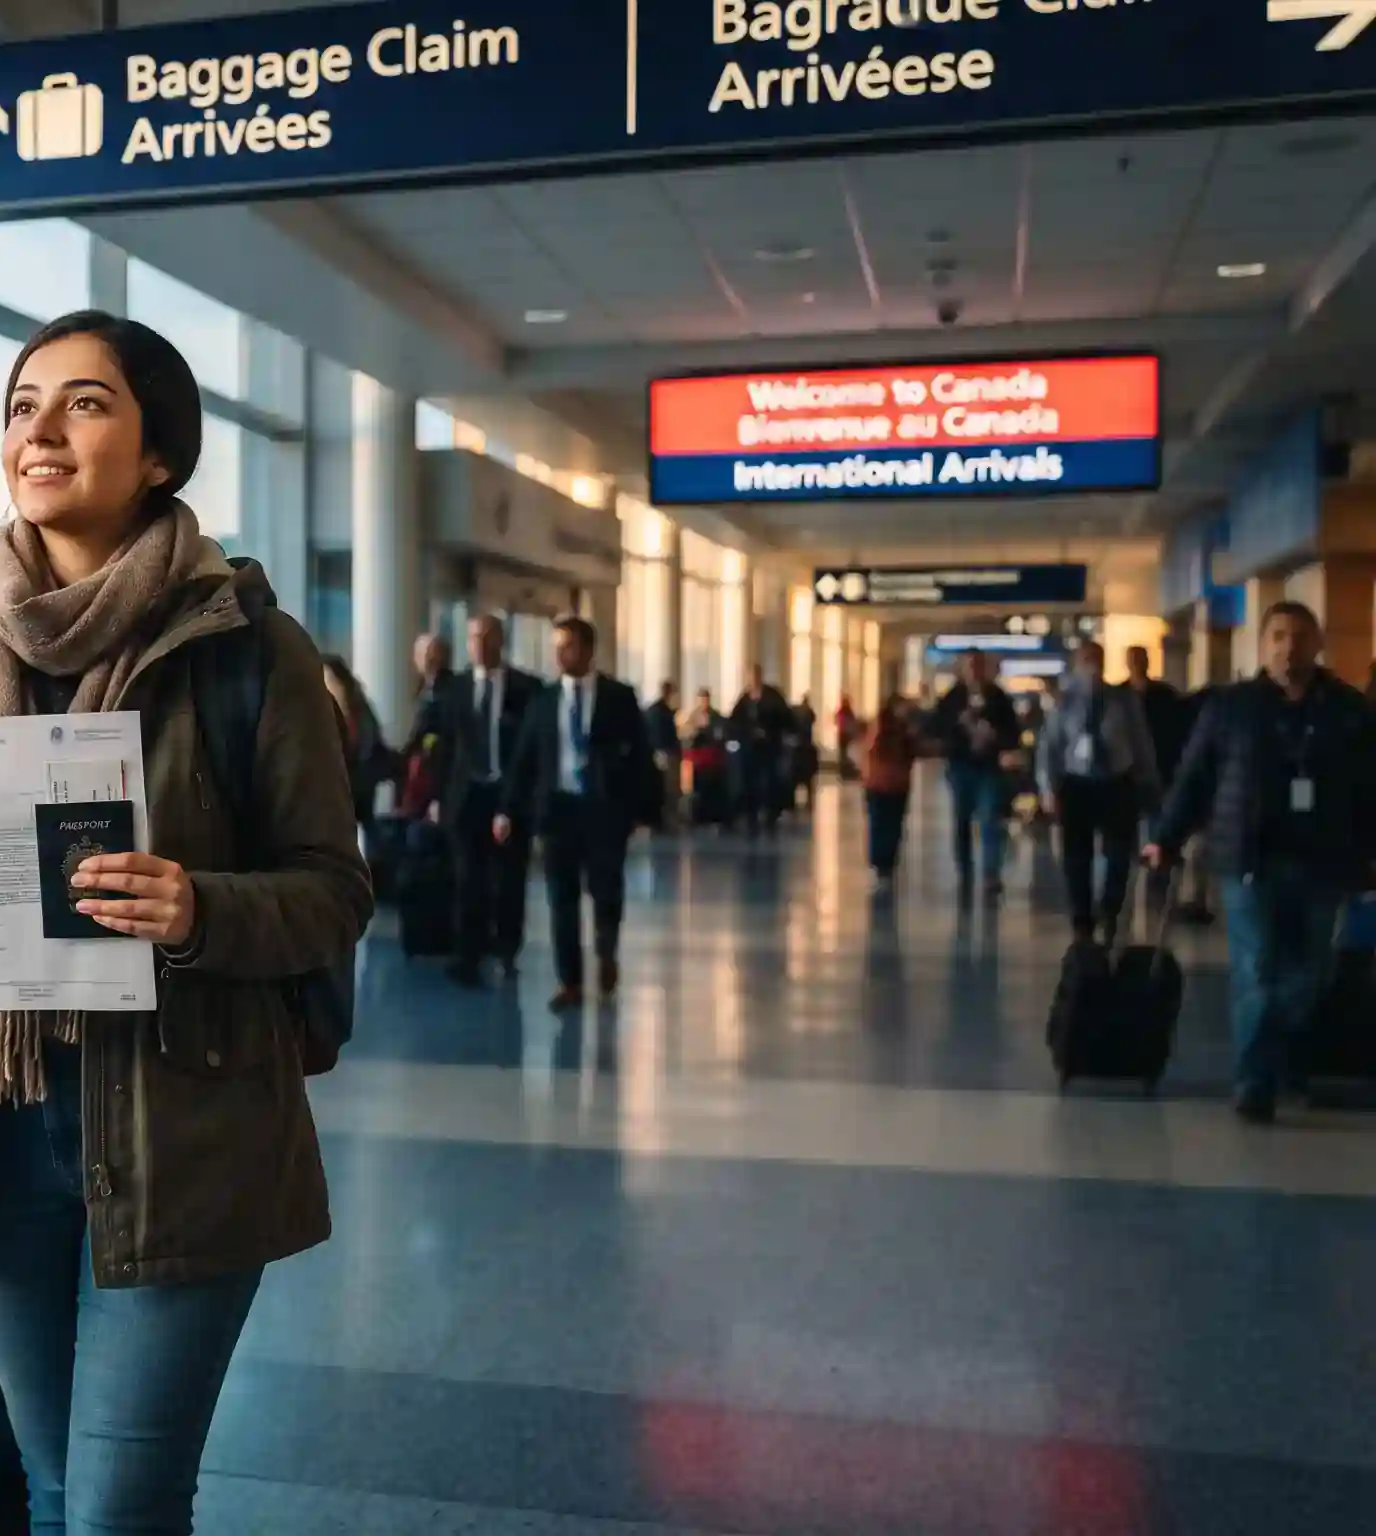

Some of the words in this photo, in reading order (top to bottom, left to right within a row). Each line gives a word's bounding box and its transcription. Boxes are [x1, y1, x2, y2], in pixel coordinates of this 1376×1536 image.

[126, 44, 352, 108] Baggage
[366, 19, 519, 77] Claim
[707, 46, 995, 113] Arrivéese
[121, 104, 332, 165] Arrivées
[747, 377, 886, 412] Welcome
[891, 379, 927, 406] to
[931, 368, 1048, 404] Canada
[896, 412, 938, 439] au
[942, 402, 1059, 437] Canada
[734, 452, 934, 491] International
[938, 446, 1063, 484] Arrivals
